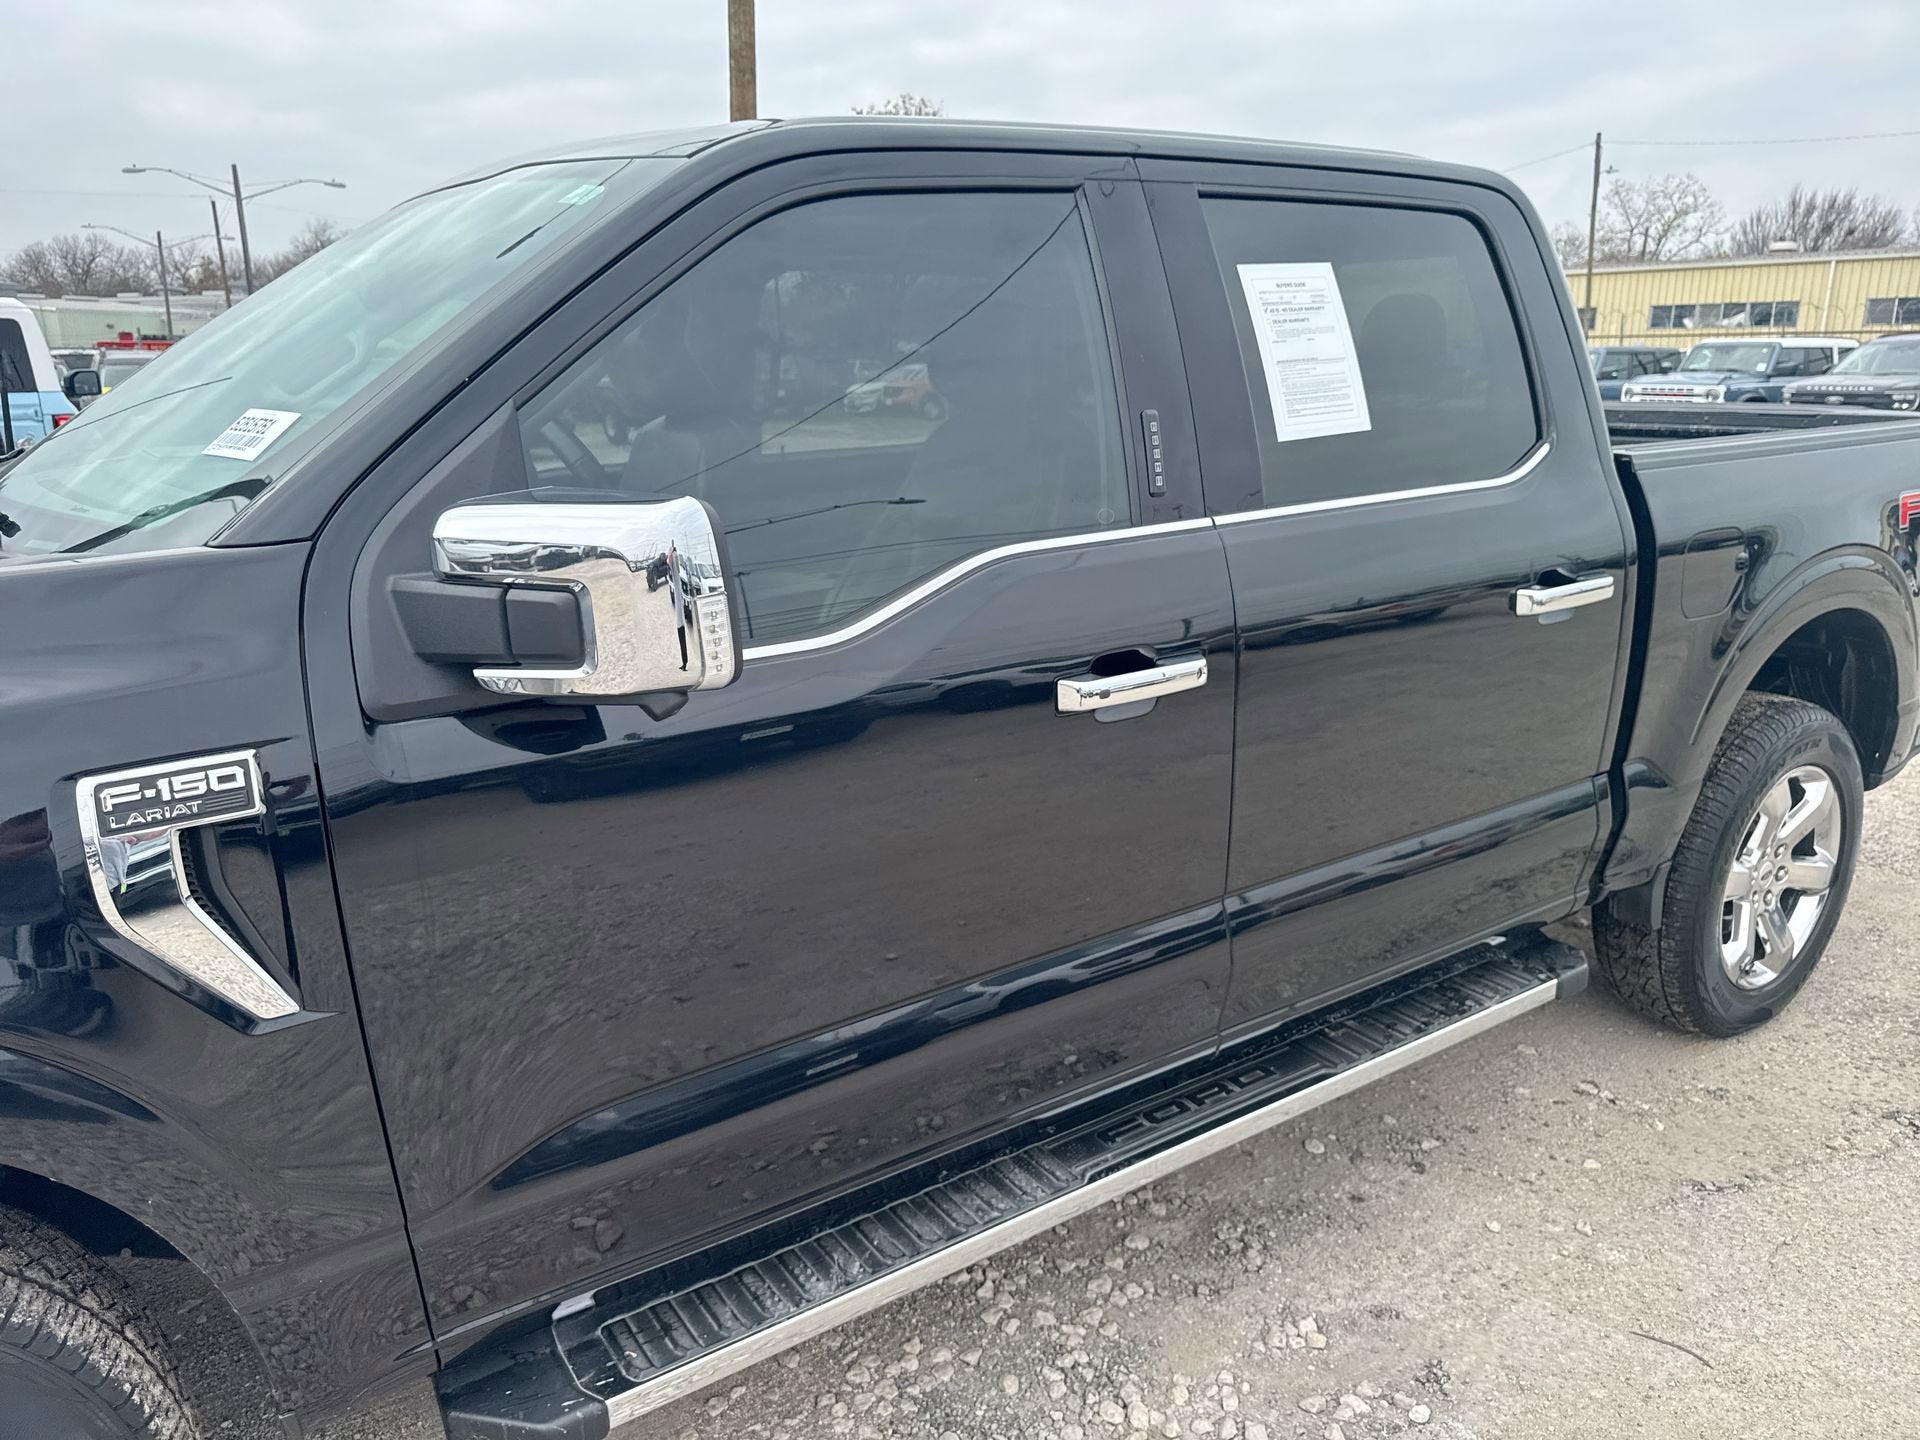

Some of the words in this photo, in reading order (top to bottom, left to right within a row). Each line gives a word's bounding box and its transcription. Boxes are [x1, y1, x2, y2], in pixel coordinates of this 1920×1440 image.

[99, 765, 246, 812] F-150
[109, 799, 202, 829] LARIAT
[1096, 1064, 1280, 1147] FORD
